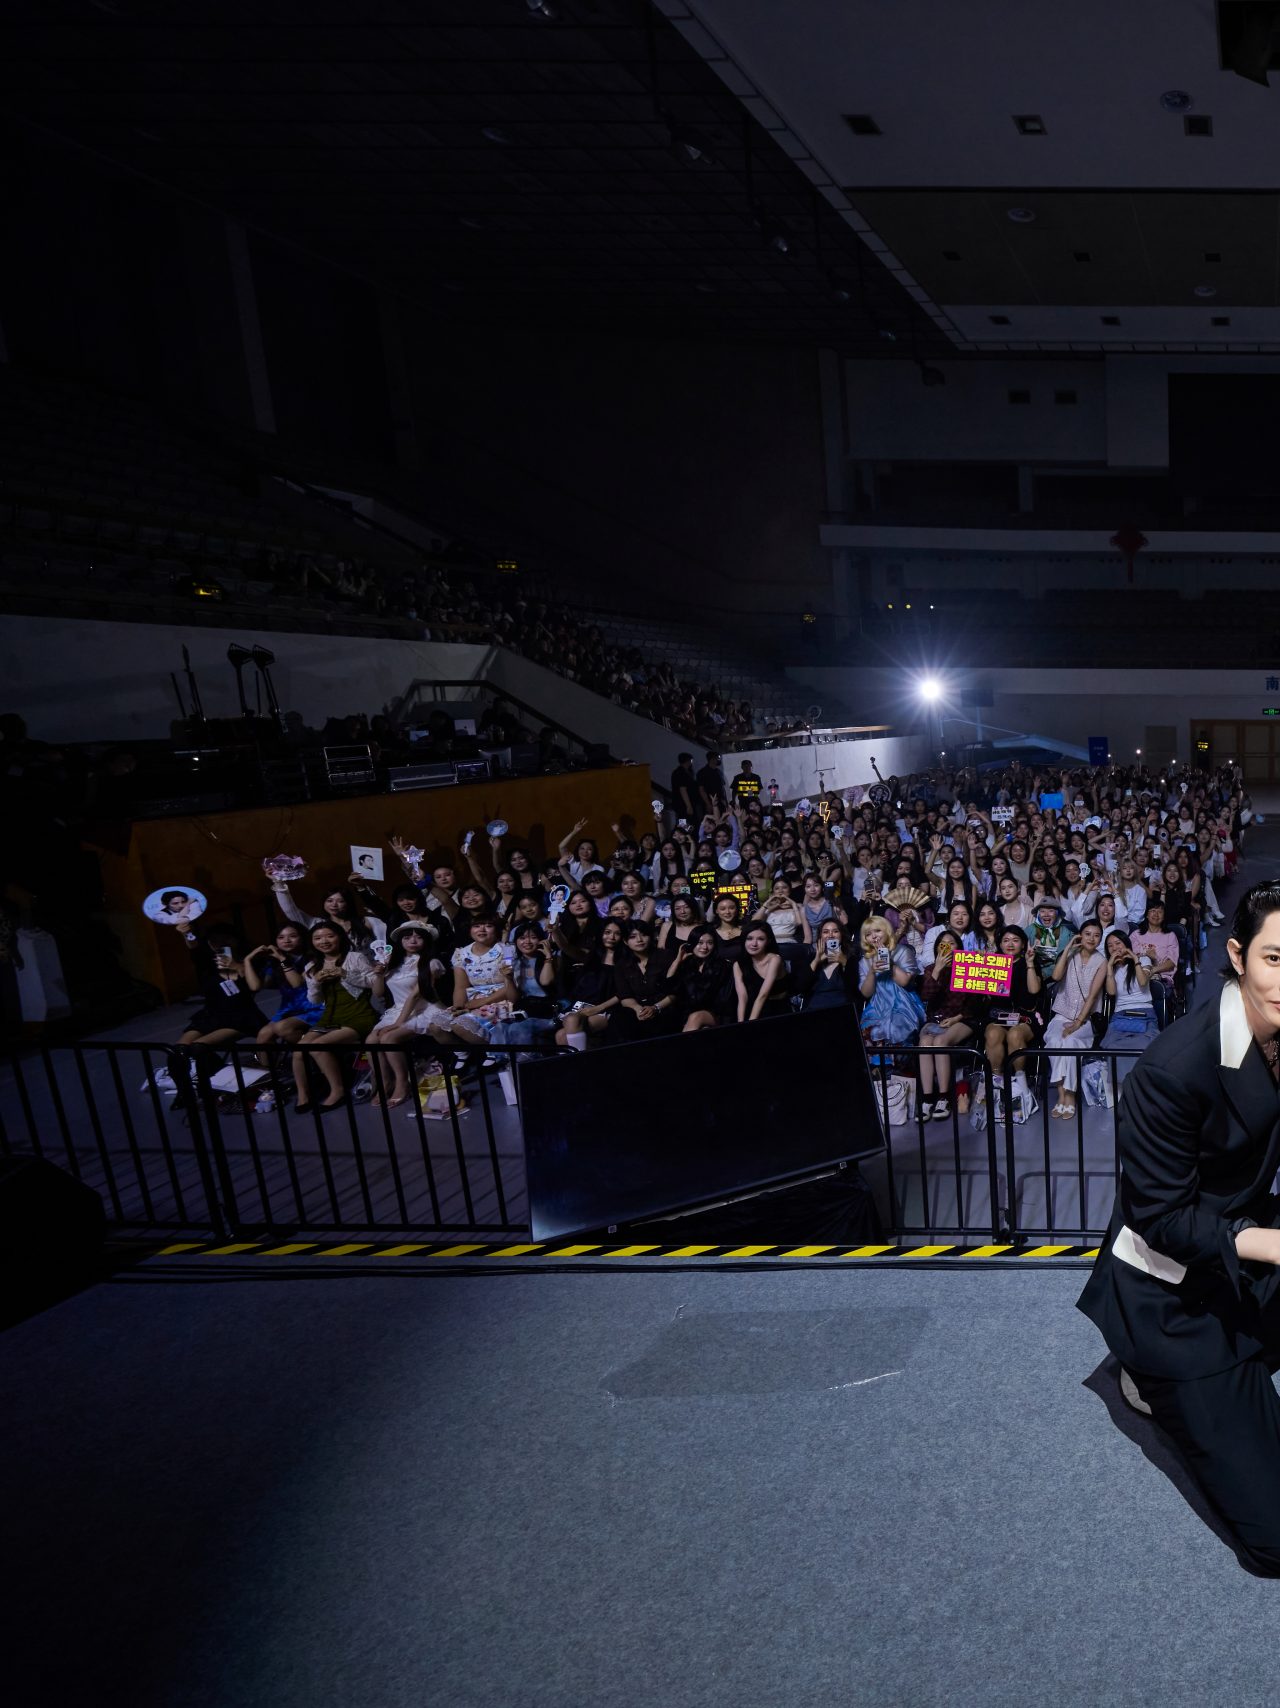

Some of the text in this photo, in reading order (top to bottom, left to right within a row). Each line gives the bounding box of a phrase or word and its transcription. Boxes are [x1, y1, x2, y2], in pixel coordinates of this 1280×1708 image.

[1265, 676, 1280, 691] 南
[954, 953, 1011, 968] 이수혁 오빠!
[955, 965, 1008, 981] 눈 마주치면
[965, 979, 987, 991] 하트
[987, 982, 998, 993] 줘
